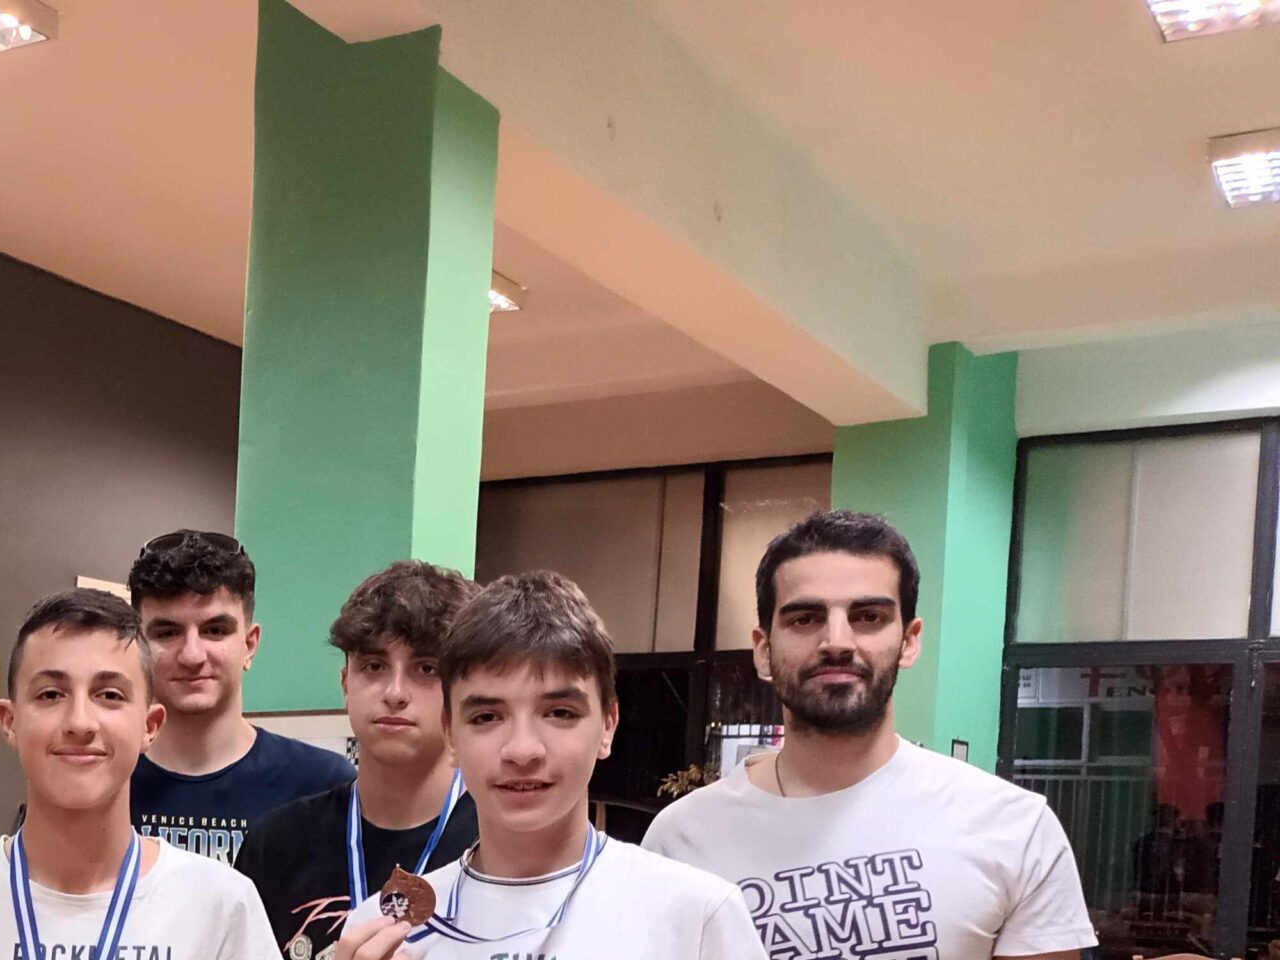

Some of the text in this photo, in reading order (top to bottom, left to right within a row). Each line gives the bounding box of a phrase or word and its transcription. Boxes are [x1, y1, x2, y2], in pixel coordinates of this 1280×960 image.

[141, 814, 248, 828] VENICE BEACH
[735, 848, 923, 918] OINT
